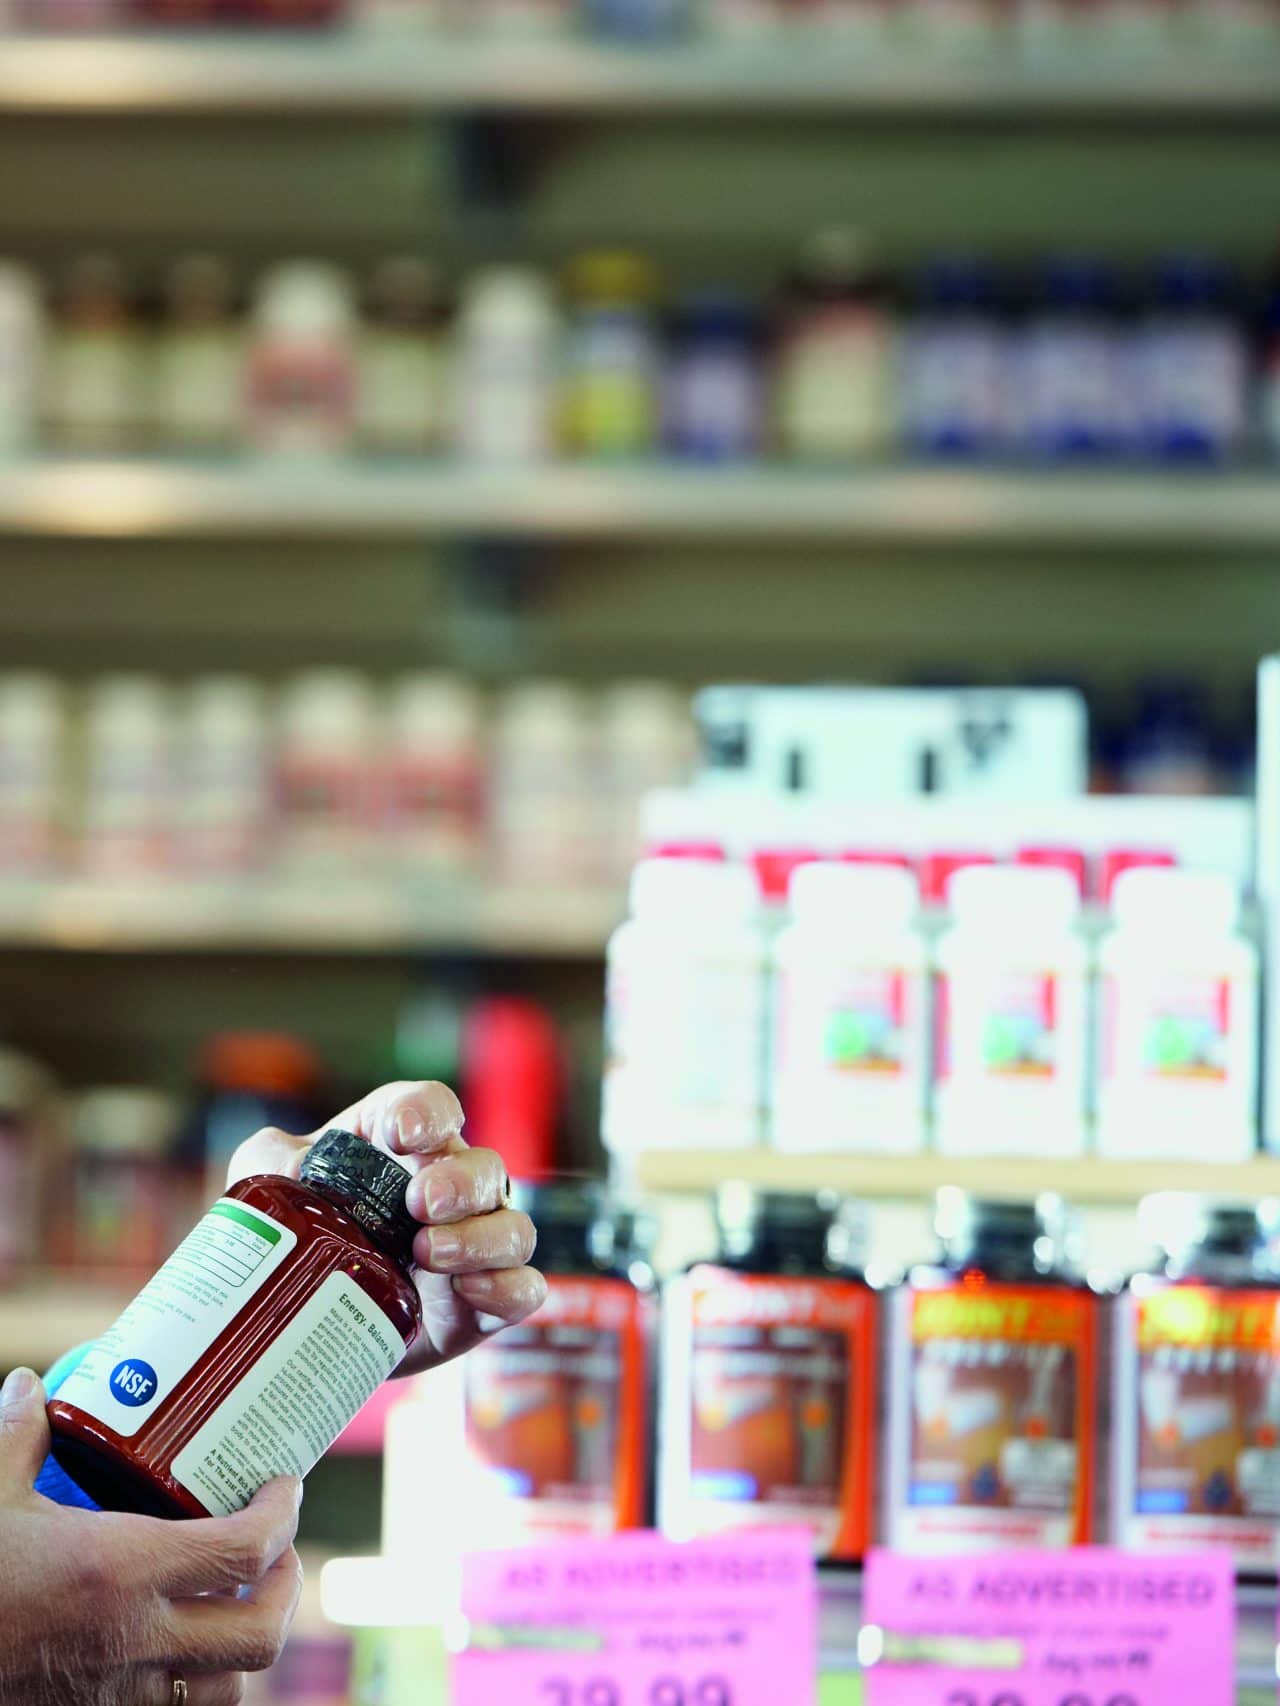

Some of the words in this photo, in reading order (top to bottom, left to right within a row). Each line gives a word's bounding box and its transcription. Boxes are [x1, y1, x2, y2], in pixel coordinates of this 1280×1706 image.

[338, 1293, 366, 1326] Energy.
[286, 1358, 297, 1370] Our
[114, 1365, 152, 1399] NSF
[203, 1455, 215, 1467] For
[214, 1465, 226, 1479] The
[216, 1453, 239, 1478] Nutrient
[237, 1475, 248, 1490] Rich
[972, 1573, 1216, 1605] ADVERTISED
